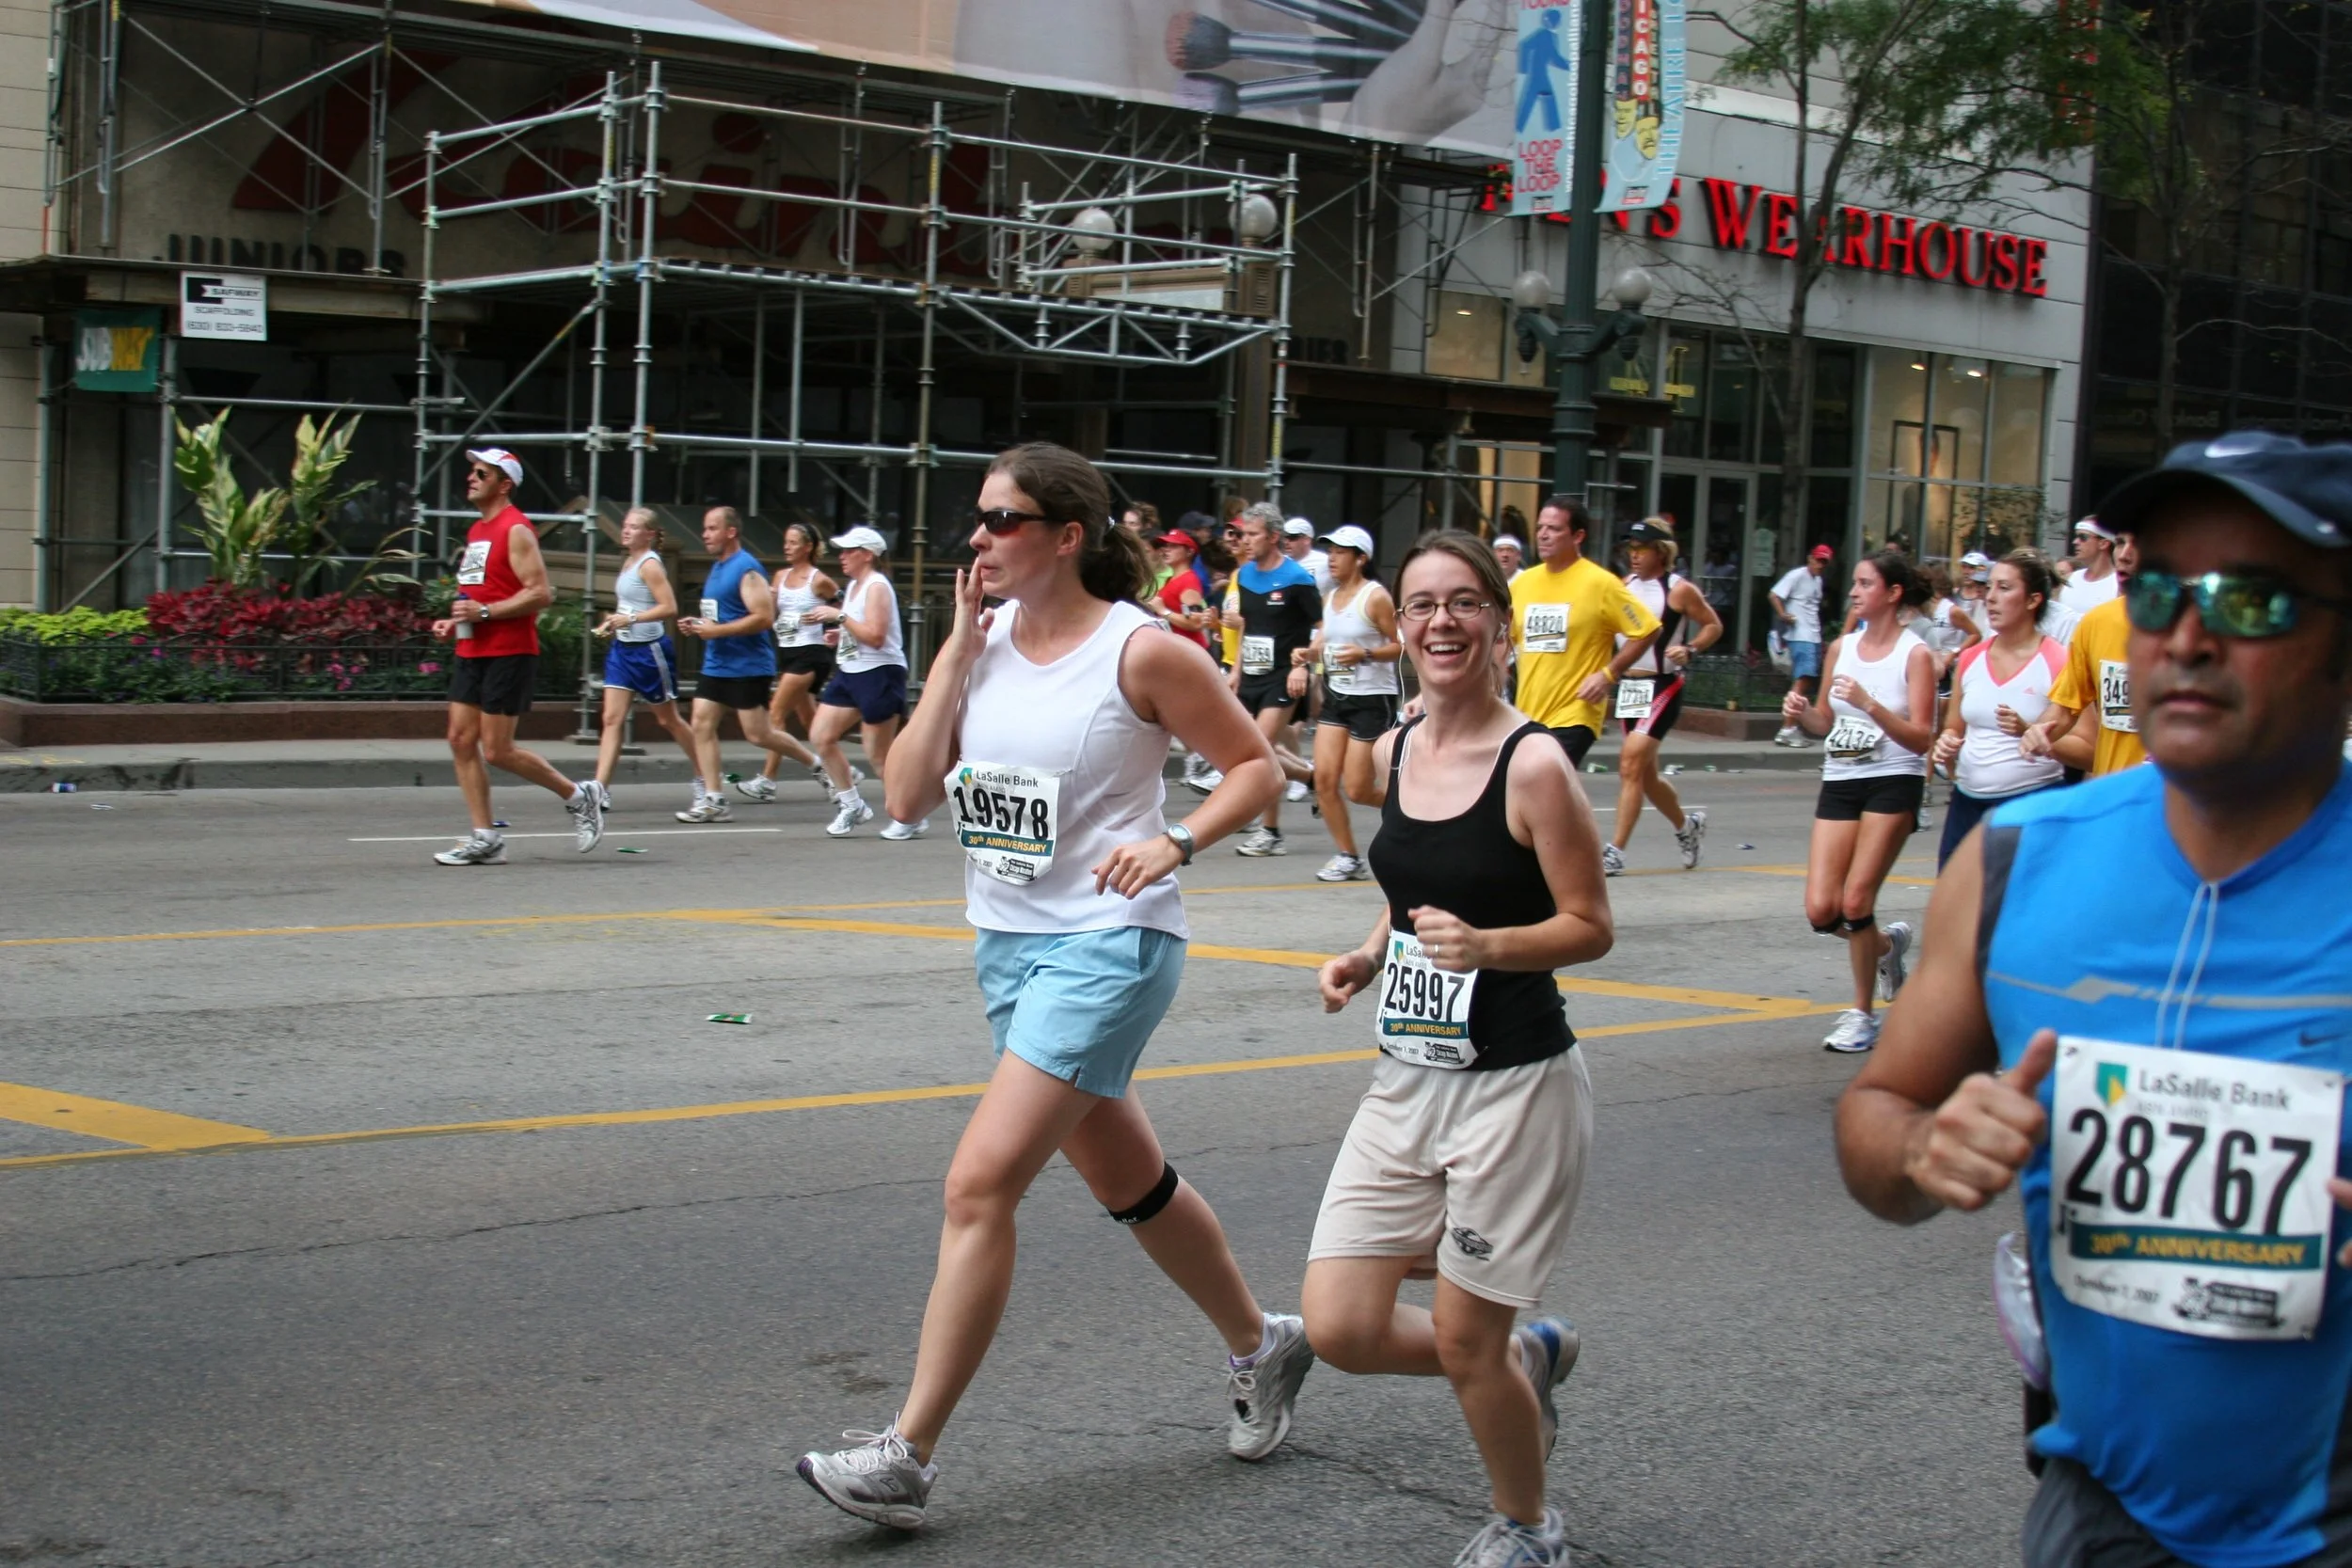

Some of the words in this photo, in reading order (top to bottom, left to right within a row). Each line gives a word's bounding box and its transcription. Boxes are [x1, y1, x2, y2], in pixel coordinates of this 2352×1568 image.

[1518, 139, 1564, 158] LOOP
[1525, 156, 1557, 176] THE
[1517, 174, 1562, 194] LOOP
[76, 326, 153, 372] SUBWAY
[2104, 678, 2130, 705] 349
[976, 769, 1010, 785] LaSalle
[1013, 774, 1039, 788] Bank
[953, 786, 1049, 841] 19578
[968, 835, 984, 846] 30th
[986, 837, 1047, 853] ANNIVERSARY
[1406, 943, 1431, 959] LaSa
[1385, 962, 1465, 1023] 25997
[1406, 1023, 1461, 1036] ANNIVERSARY
[2137, 1069, 2222, 1101] LaSalle
[2231, 1082, 2290, 1111] Bank
[2066, 1108, 2312, 1236] 28767
[2090, 1232, 2133, 1254] 30th
[2136, 1235, 2305, 1265] ANNIVERSARY
